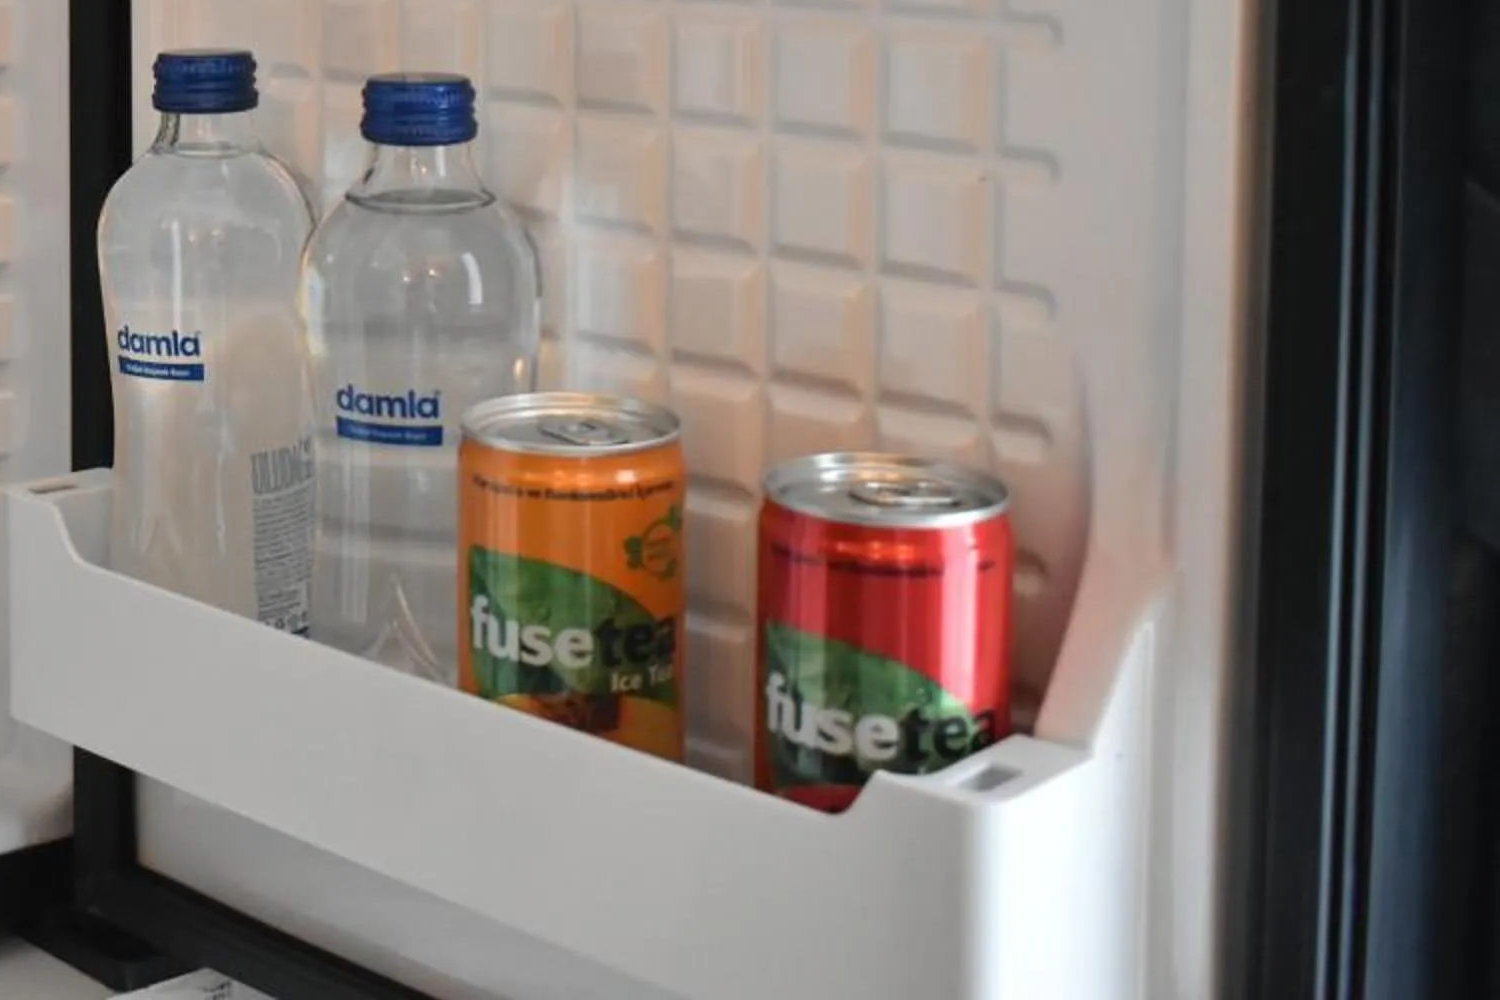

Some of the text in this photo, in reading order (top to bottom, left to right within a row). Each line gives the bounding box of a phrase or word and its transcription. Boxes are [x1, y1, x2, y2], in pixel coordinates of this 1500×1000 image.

[117, 325, 201, 357] damla
[336, 383, 440, 419] damla
[610, 669, 643, 693] Ice
